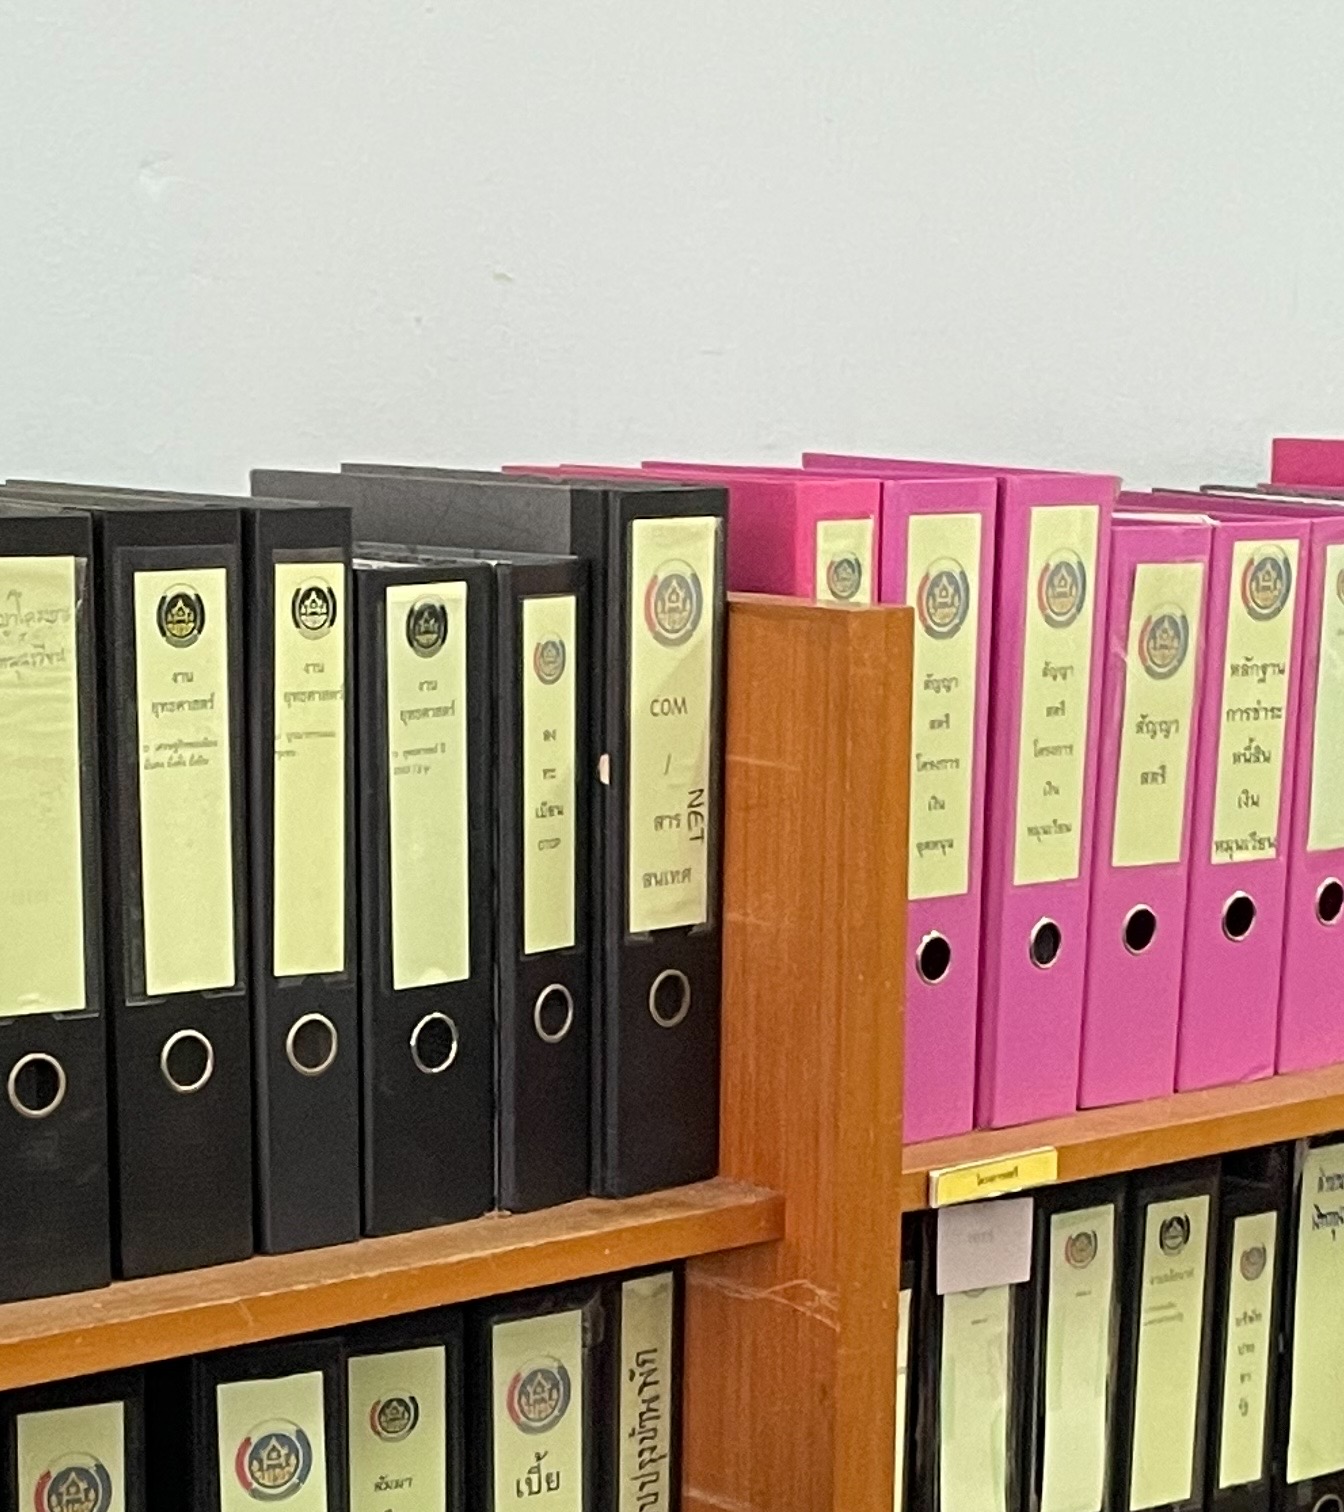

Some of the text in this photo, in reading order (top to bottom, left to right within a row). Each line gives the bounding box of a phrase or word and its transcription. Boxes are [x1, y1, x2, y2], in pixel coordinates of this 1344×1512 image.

[172, 671, 194, 684] งาน
[303, 662, 325, 675] งาน
[1041, 660, 1074, 682] สัญญา
[1230, 655, 1286, 684] หลักฐาน
[417, 679, 438, 692] งาน
[923, 673, 959, 694] สัญญา
[649, 696, 688, 717] COM
[1225, 699, 1283, 723] การชำระ
[1135, 713, 1180, 740] สัญญา
[1140, 764, 1167, 786] สตรี
[1237, 788, 1260, 809] เงิน
[653, 813, 681, 832] สาร
[687, 787, 705, 843] NET
[373, 1474, 414, 1493] สัมมา
[515, 1450, 561, 1499] เปี้ย
